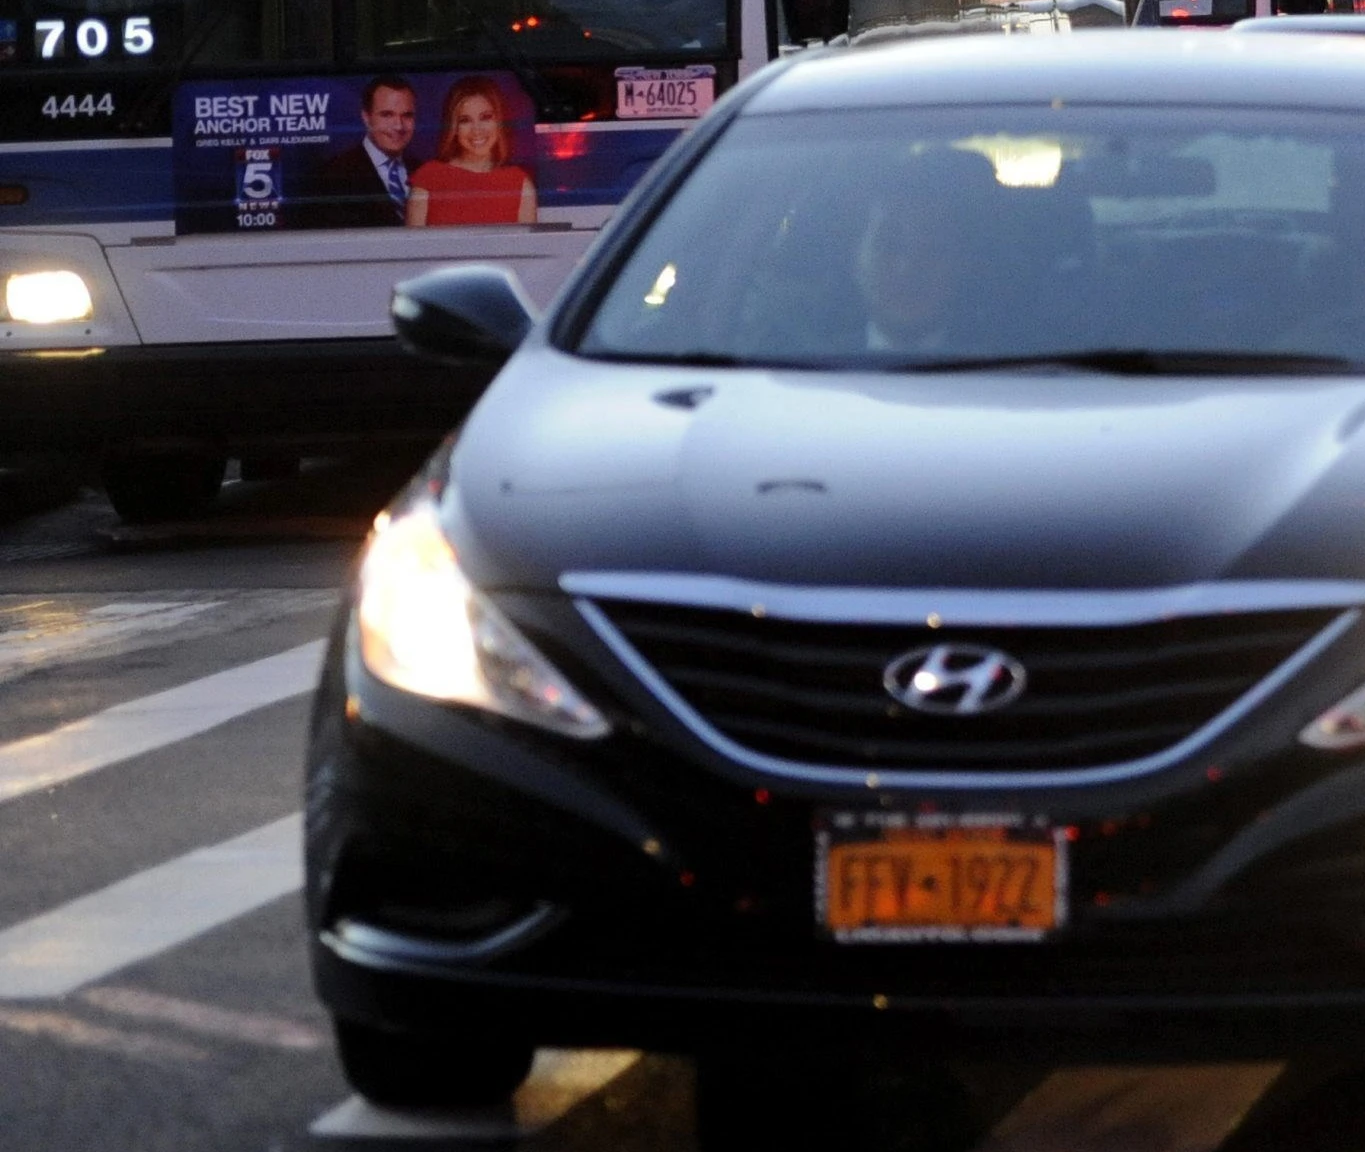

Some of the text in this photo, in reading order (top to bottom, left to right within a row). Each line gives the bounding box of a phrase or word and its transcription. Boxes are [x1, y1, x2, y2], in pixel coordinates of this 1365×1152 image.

[35, 16, 155, 58] 705
[42, 93, 115, 119] 4444
[195, 93, 330, 119] BEST NEW
[194, 115, 326, 135] ANCHOR TEAM
[221, 138, 247, 146] KELLY
[281, 134, 330, 144] ALEXANDER
[245, 149, 270, 161] FOX
[243, 162, 273, 199] 5
[236, 212, 276, 227] 10:00
